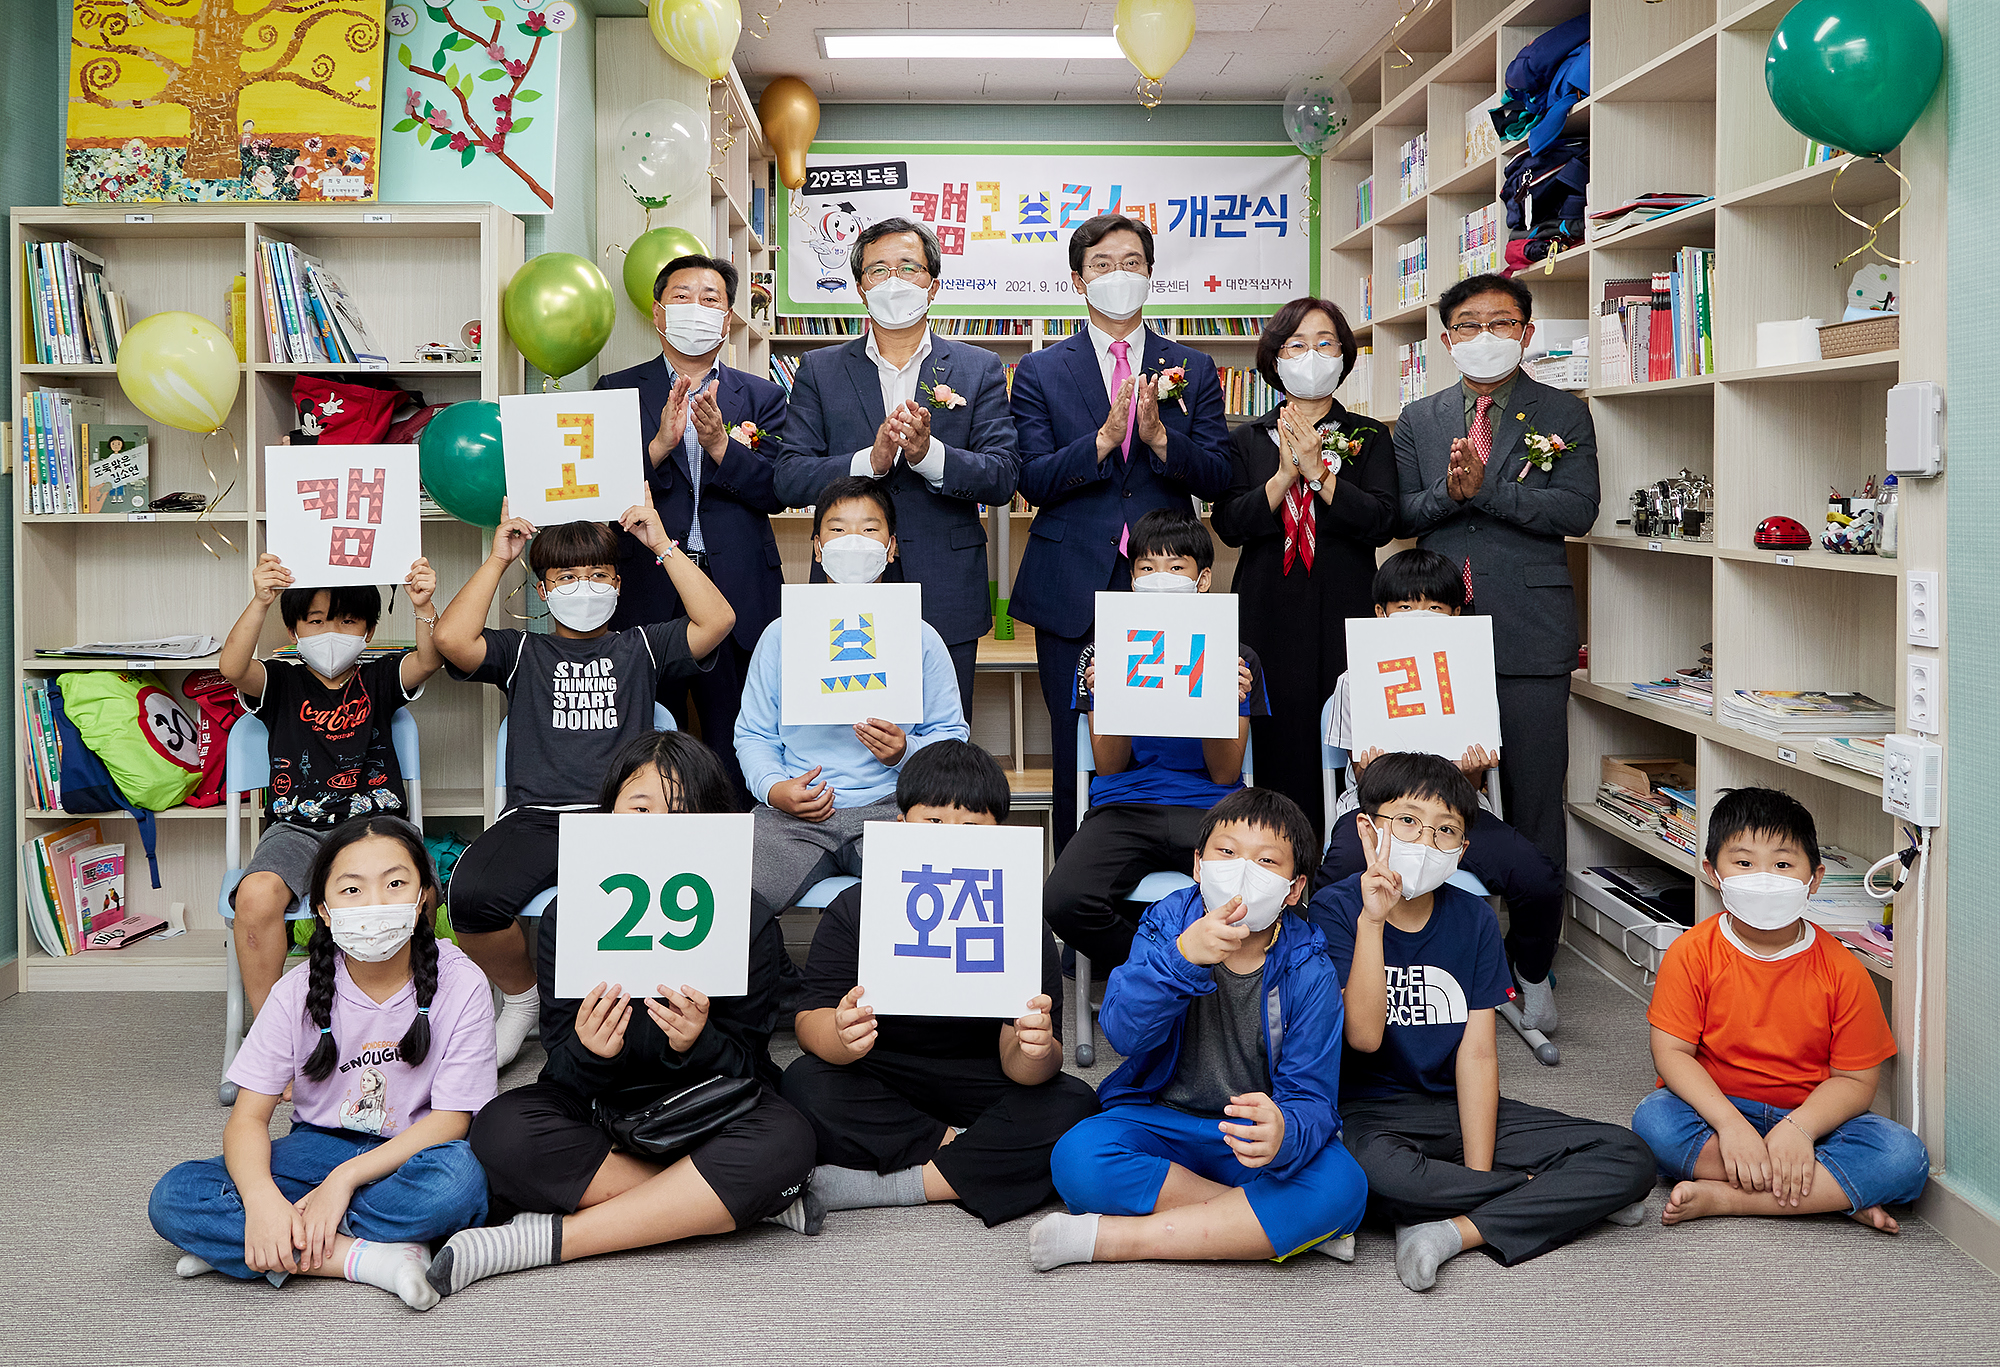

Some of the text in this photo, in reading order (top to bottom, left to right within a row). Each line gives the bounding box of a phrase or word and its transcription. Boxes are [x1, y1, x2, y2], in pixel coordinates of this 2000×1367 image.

[809, 166, 899, 189] 29호점 도동
[1167, 193, 1289, 238] 개관식
[1005, 280, 1036, 293] 2021.
[1039, 280, 1050, 293] 9.
[1054, 280, 1068, 292] 10
[1226, 278, 1293, 291] 대한적십자사
[93, 455, 131, 478] 도둑맞은
[545, 413, 600, 503] 코
[110, 464, 140, 484] 김소연
[296, 467, 386, 569] 캠
[1126, 628, 1206, 698] 러
[552, 677, 618, 692] THINKING
[552, 691, 617, 709] START
[153, 708, 198, 752] 30
[552, 708, 619, 731] DOING
[597, 871, 715, 952] 29
[893, 863, 1006, 974] 호점
[1384, 965, 1423, 986] THE
[1386, 985, 1425, 1006] RTH
